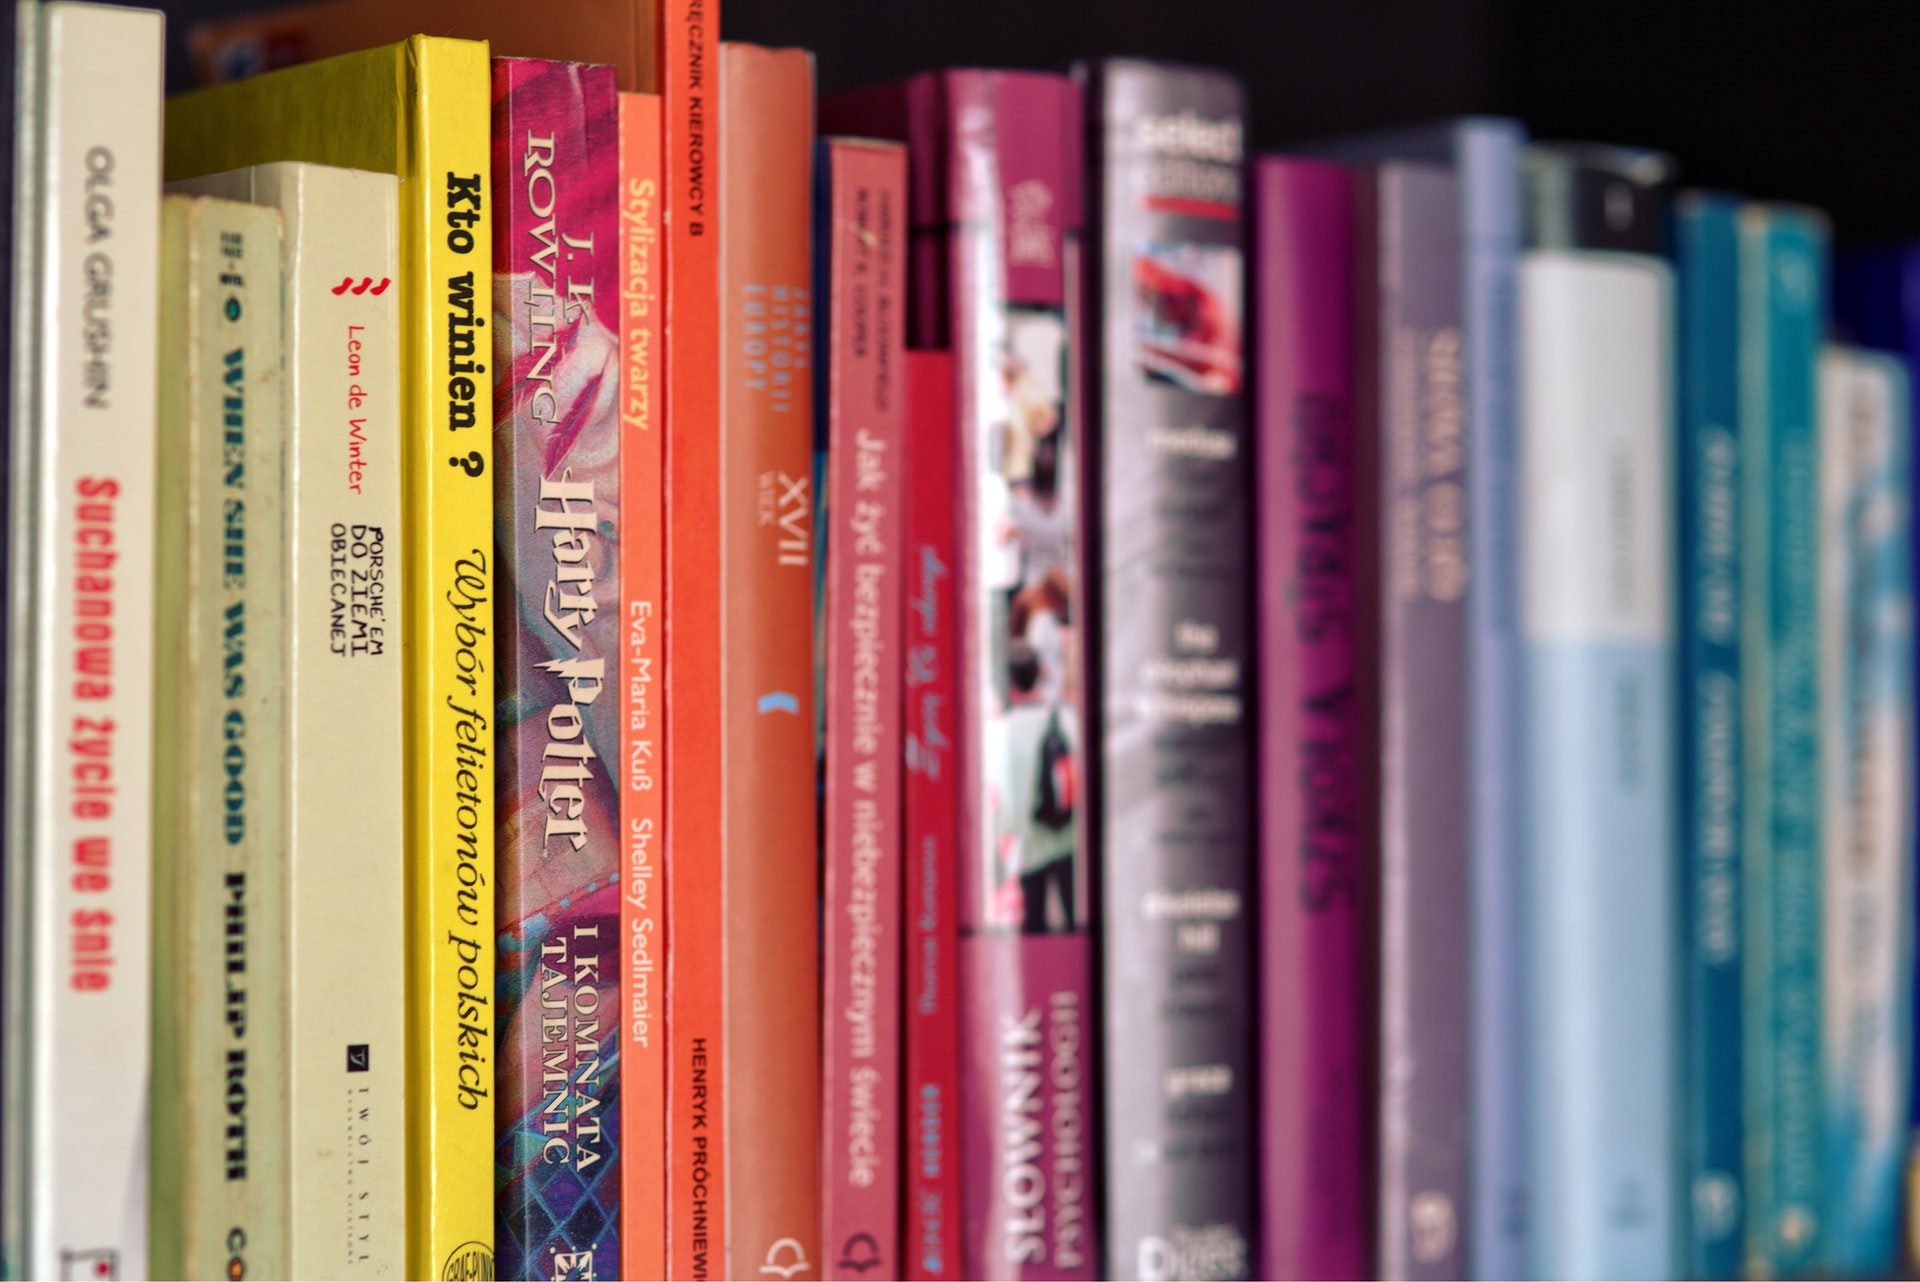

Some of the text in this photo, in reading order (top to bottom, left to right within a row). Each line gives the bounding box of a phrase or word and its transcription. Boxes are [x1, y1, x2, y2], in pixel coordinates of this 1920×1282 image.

[688, 97, 705, 215] KIEROWCY
[689, 222, 705, 237] B
[83, 146, 115, 409] OLGA GRUSHIN
[446, 172, 485, 479] Kto winien ?
[522, 128, 561, 426] ROWLING
[562, 231, 594, 326] J. K.
[623, 178, 655, 431] Stylizacja twarzy
[742, 283, 767, 392] EUROPY
[771, 285, 791, 412] HISTORII
[347, 325, 368, 495] Leon de Winter
[777, 471, 810, 566] XVII
[223, 348, 246, 845] WHEN SHE WAS GOOD
[329, 523, 348, 656] OBIECANEJ
[350, 525, 369, 657] DO ZIEMI
[367, 526, 387, 656] PORSCHE'EM
[532, 466, 605, 853] Harry Potter
[629, 600, 653, 792] Eva-Maria Kuß
[68, 476, 120, 993] Suchanowa życie we śnie
[446, 548, 489, 1111] Wybór felietonów polskich
[845, 429, 887, 1187] Jak żyć bezpiecznie w niebezpiecznym świecie
[224, 873, 248, 1182] PHILIP ROTH
[571, 924, 602, 1173] I KOMNATA
[626, 818, 653, 1049] Shelley Sedlmaier
[539, 936, 569, 1167] TAJEMNIC
[691, 1038, 711, 1282] HENRYK PRÓCHNIEWI
[357, 1087, 372, 1264] TWÓJ STYL
